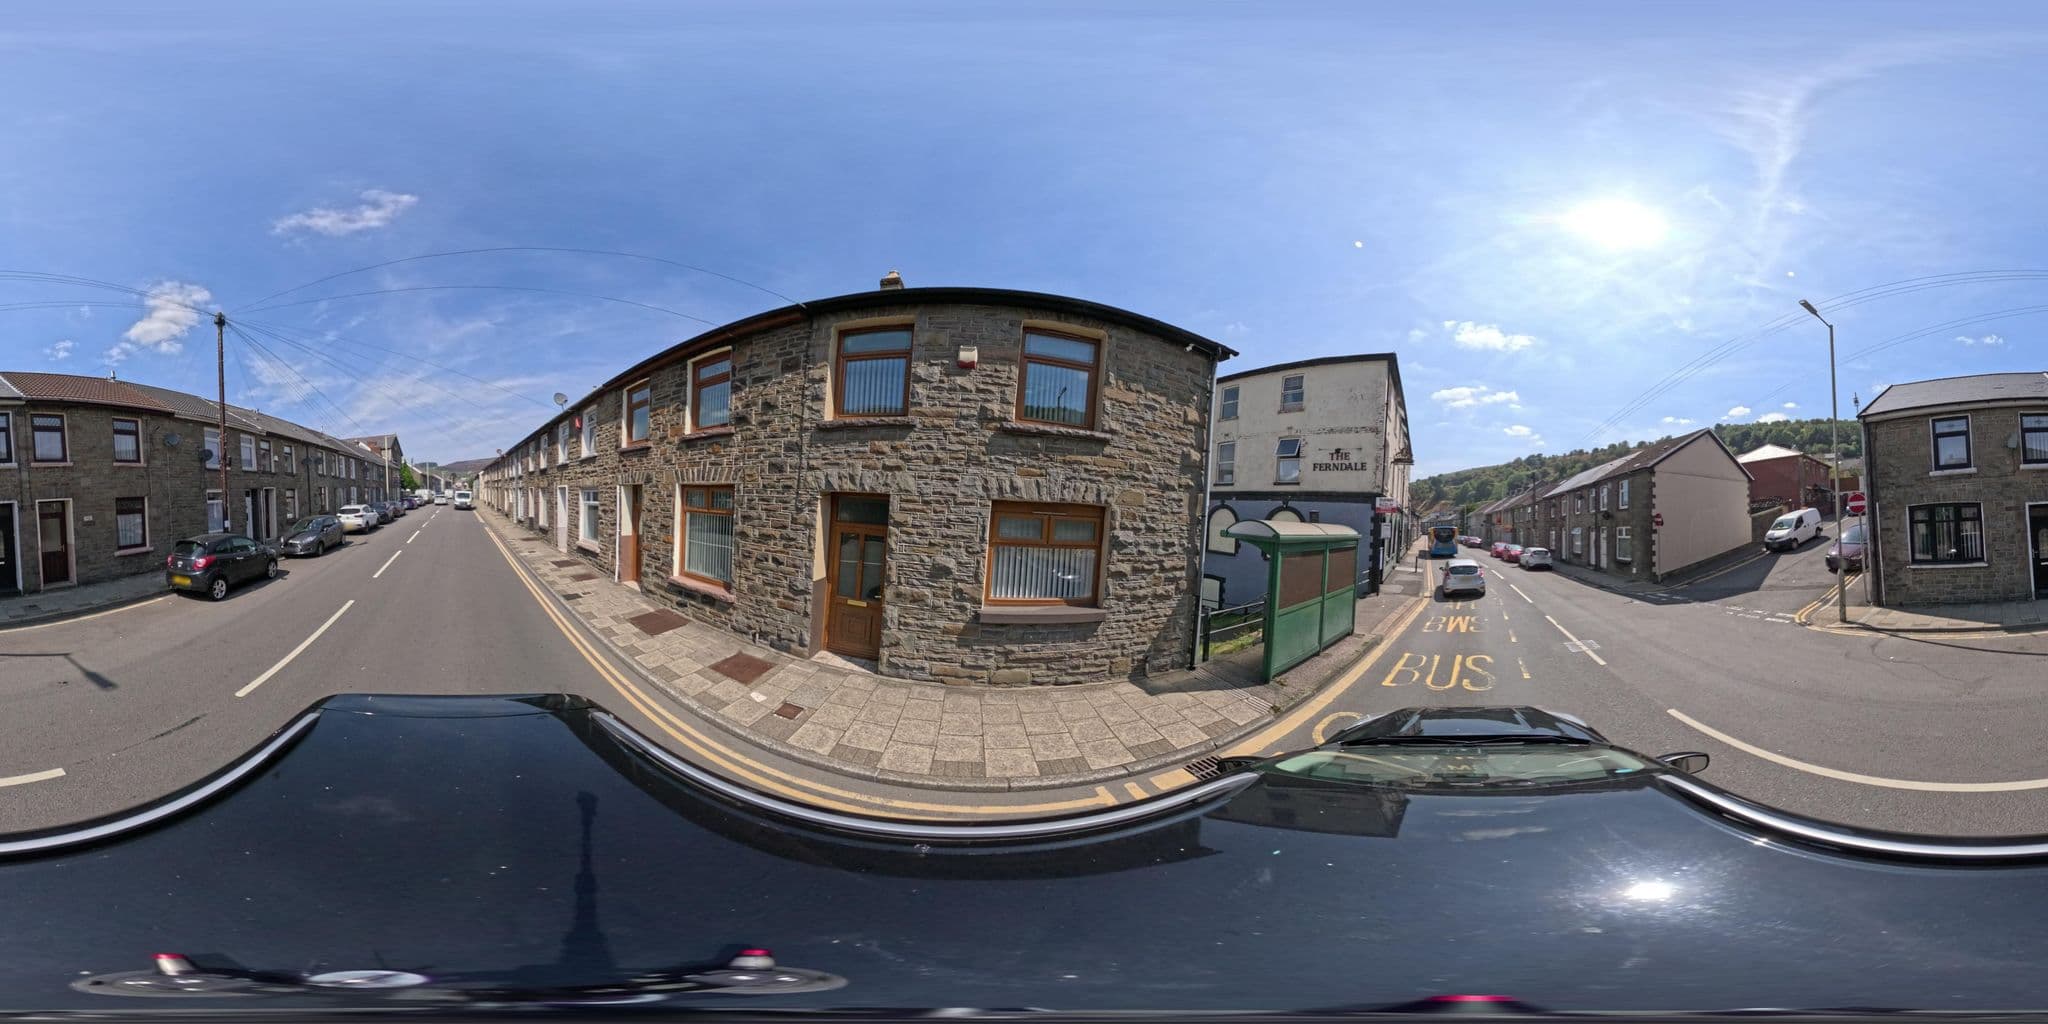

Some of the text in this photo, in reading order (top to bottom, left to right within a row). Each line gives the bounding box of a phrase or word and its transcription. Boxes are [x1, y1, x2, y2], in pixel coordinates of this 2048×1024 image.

[1329, 452, 1351, 461] THE
[1312, 462, 1367, 471] FERNDALE
[1381, 652, 1496, 691] BUS
